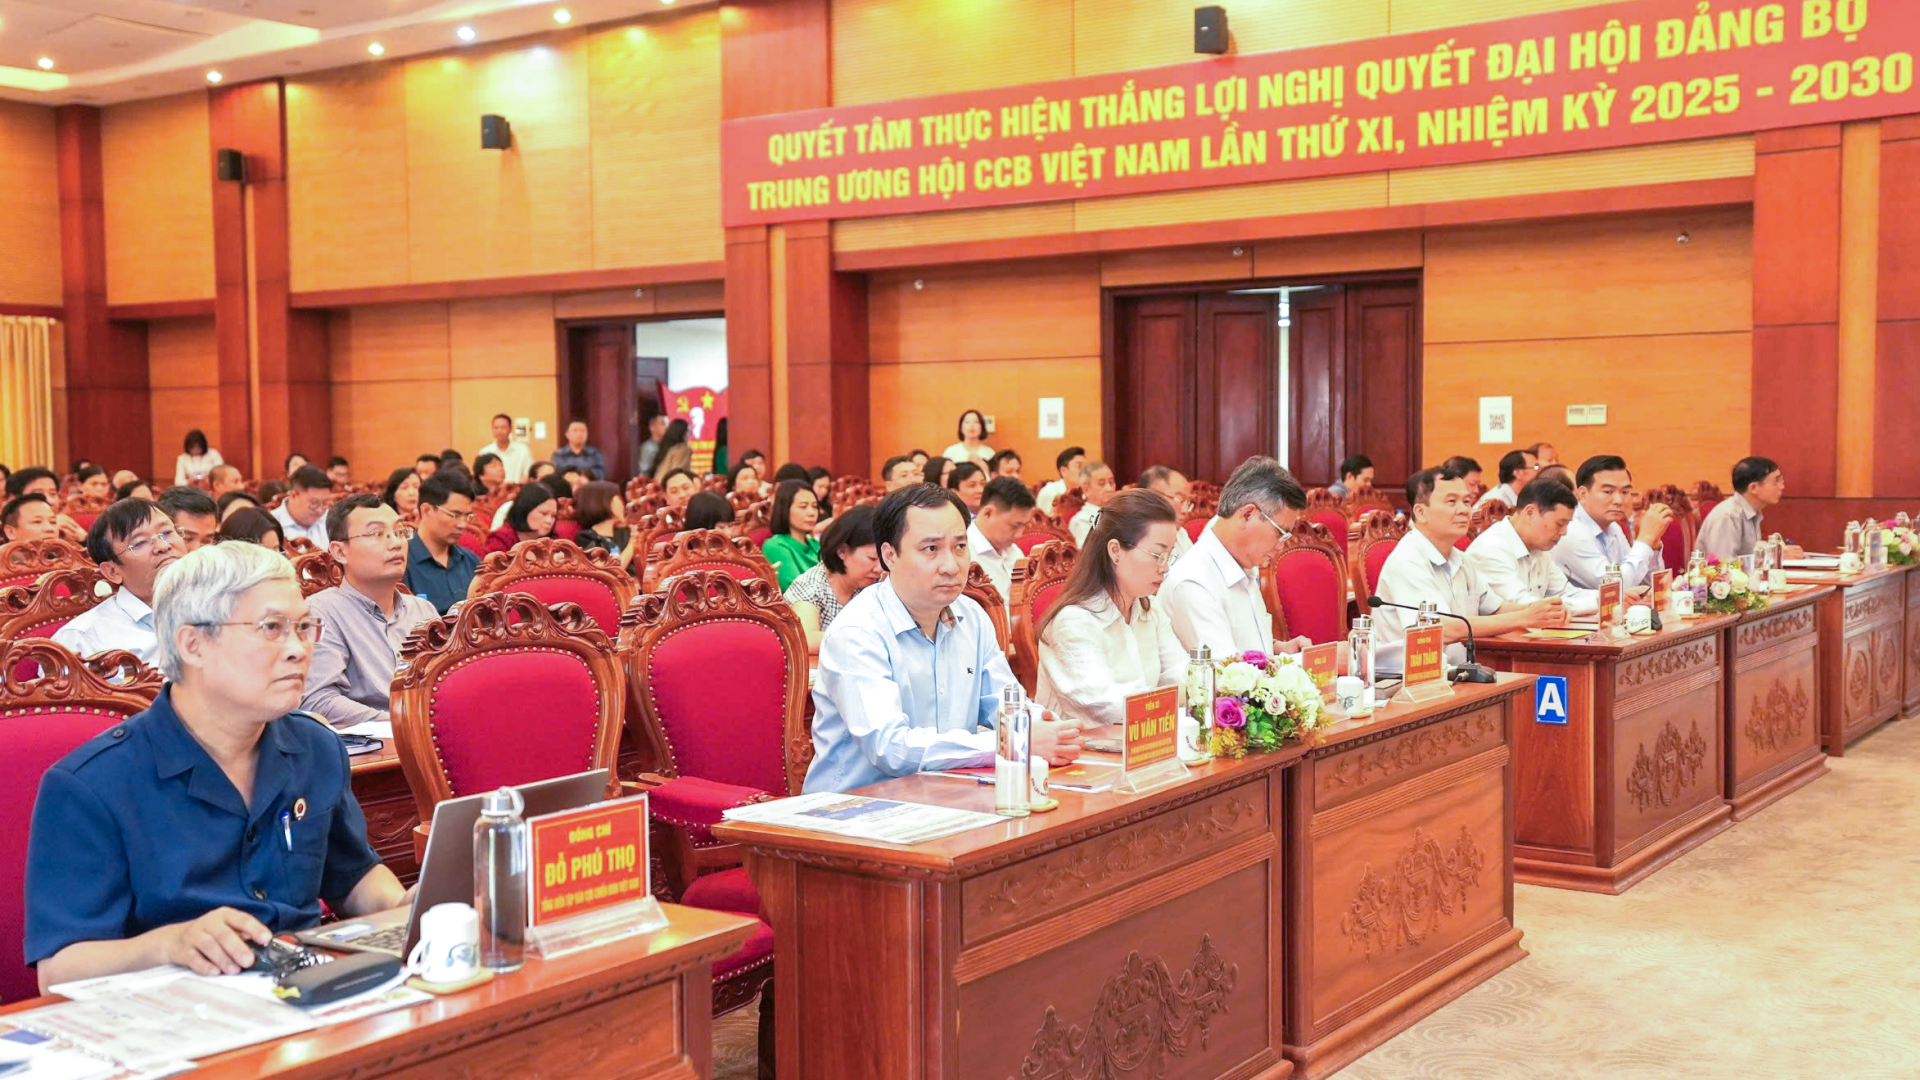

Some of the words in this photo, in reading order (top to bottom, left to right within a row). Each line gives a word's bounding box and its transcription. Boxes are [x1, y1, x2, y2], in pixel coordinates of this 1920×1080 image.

[767, 118, 847, 166] QUYẾT
[853, 116, 912, 153] TÂM
[919, 108, 992, 149] THỰC
[1001, 96, 1071, 141] HIỆN
[1079, 80, 1185, 129] THẮNG
[1196, 75, 1247, 121] LỢI
[1258, 65, 1344, 109] NGHỊ
[1356, 38, 1475, 100] QUYẾT
[1486, 36, 1555, 82] ĐẠI
[1570, 19, 1641, 73] HỘI
[1655, 3, 1784, 58] ĐẢNG
[747, 175, 830, 211] TRUNG
[837, 167, 910, 203] ƯƠNG
[919, 157, 965, 200] HỘI
[974, 155, 1032, 190] CCB
[1041, 143, 1106, 188] VIỆT
[1115, 138, 1190, 177] NAM
[1201, 121, 1266, 168] LẦN
[1277, 114, 1349, 161] THỨ
[1357, 115, 1405, 154] XI,
[1418, 95, 1548, 147] NHIỆM
[1563, 82, 1616, 131] KỲ
[1630, 74, 1740, 123] 2025
[1790, 53, 1912, 104] 2030
[1538, 682, 1566, 717] A
[1141, 717, 1157, 739] VĂN
[1158, 710, 1175, 733] TIẾN
[545, 852, 567, 887] ĐỖ
[571, 846, 603, 881] PHÚ
[606, 844, 636, 873] THỌ
